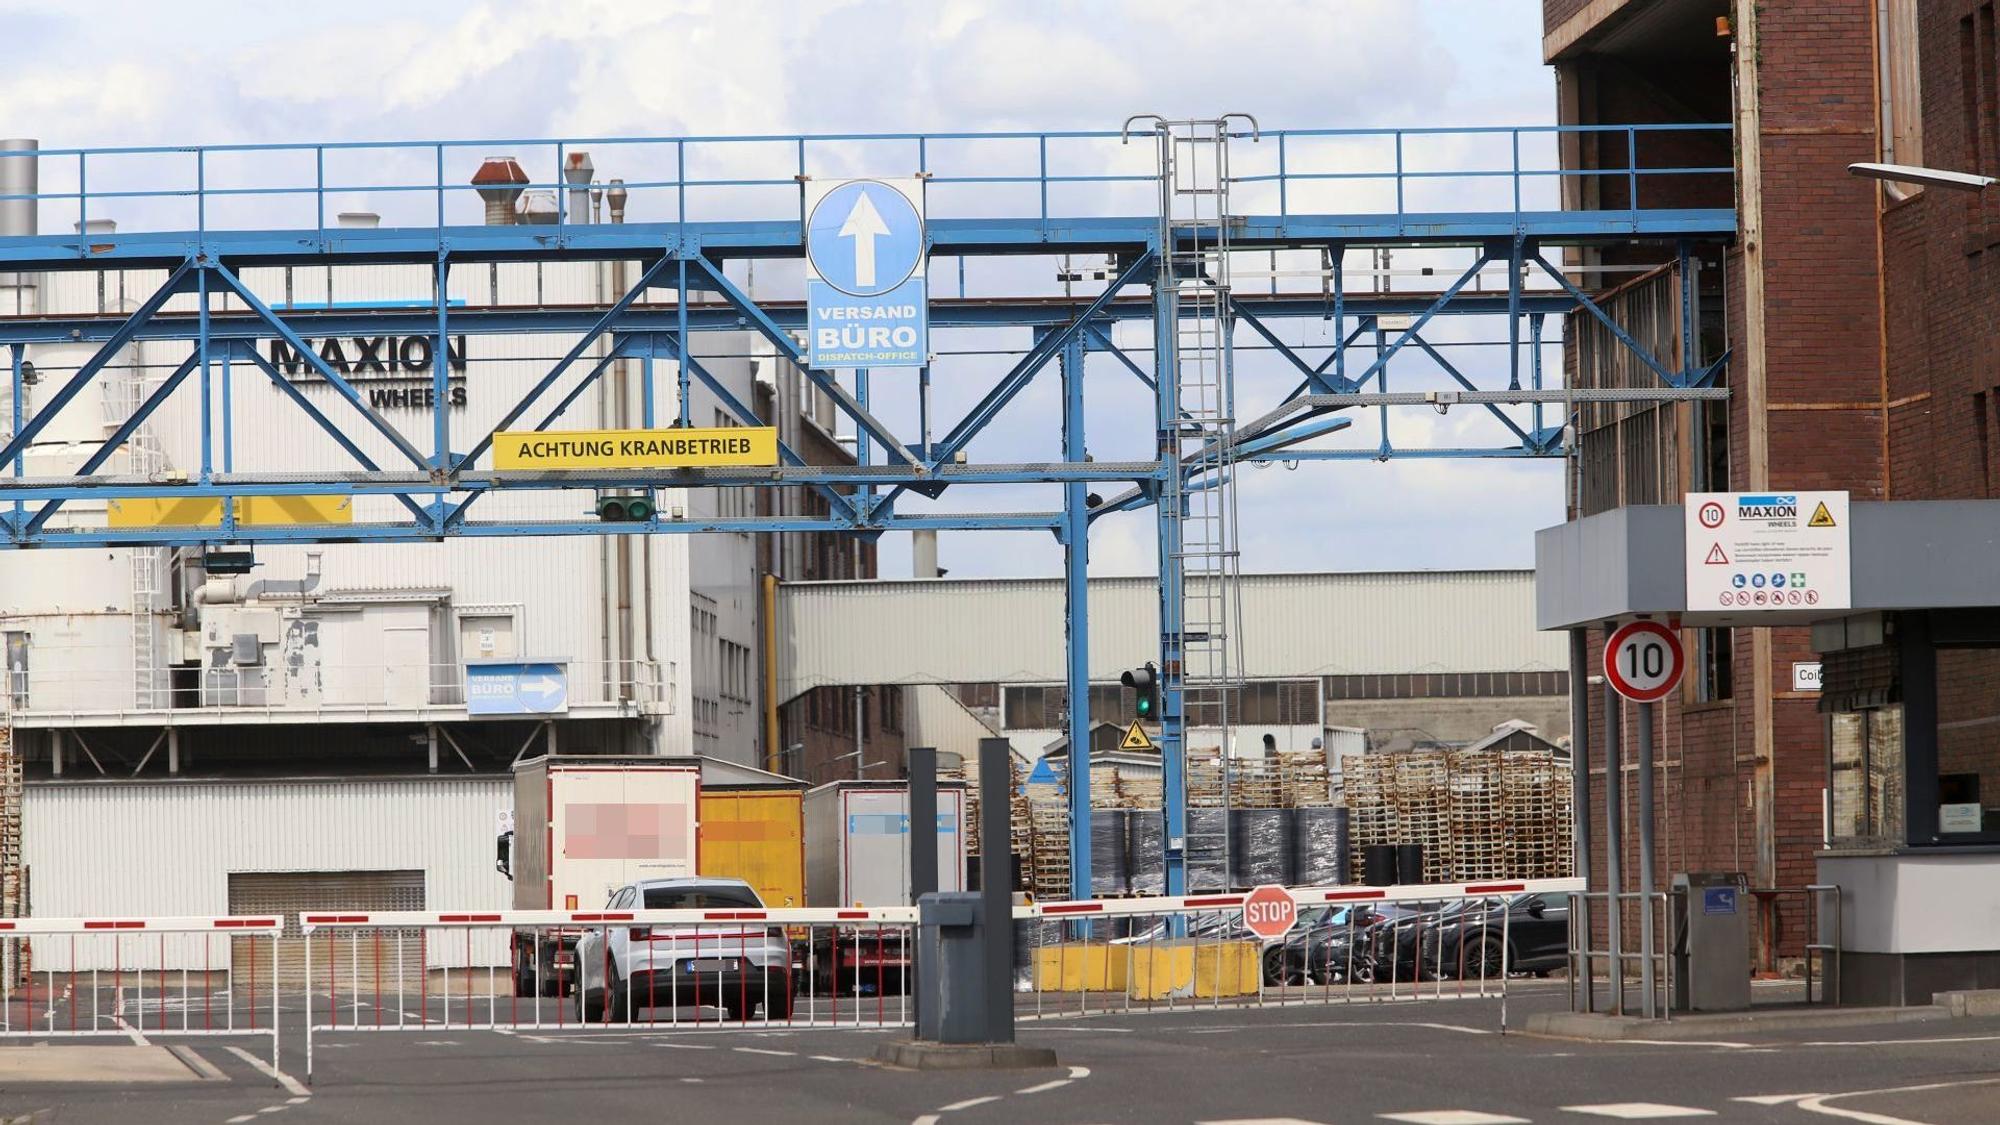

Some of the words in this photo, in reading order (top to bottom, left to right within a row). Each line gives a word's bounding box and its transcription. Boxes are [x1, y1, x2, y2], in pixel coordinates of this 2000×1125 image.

[817, 305, 917, 320] VERSAND
[817, 323, 917, 349] BÜRO
[271, 335, 466, 373] MAXION
[818, 352, 918, 361] DISPATCH-OFFICE
[369, 387, 467, 407] WHEES
[518, 441, 614, 458] ACHTUNG
[620, 438, 751, 456] KRANBETRIEB
[1705, 509, 1719, 522] 10
[1739, 506, 1797, 517] MAXION
[1626, 643, 1664, 678] 10
[472, 682, 513, 694] BÜRO
[1249, 901, 1291, 922] STOP
